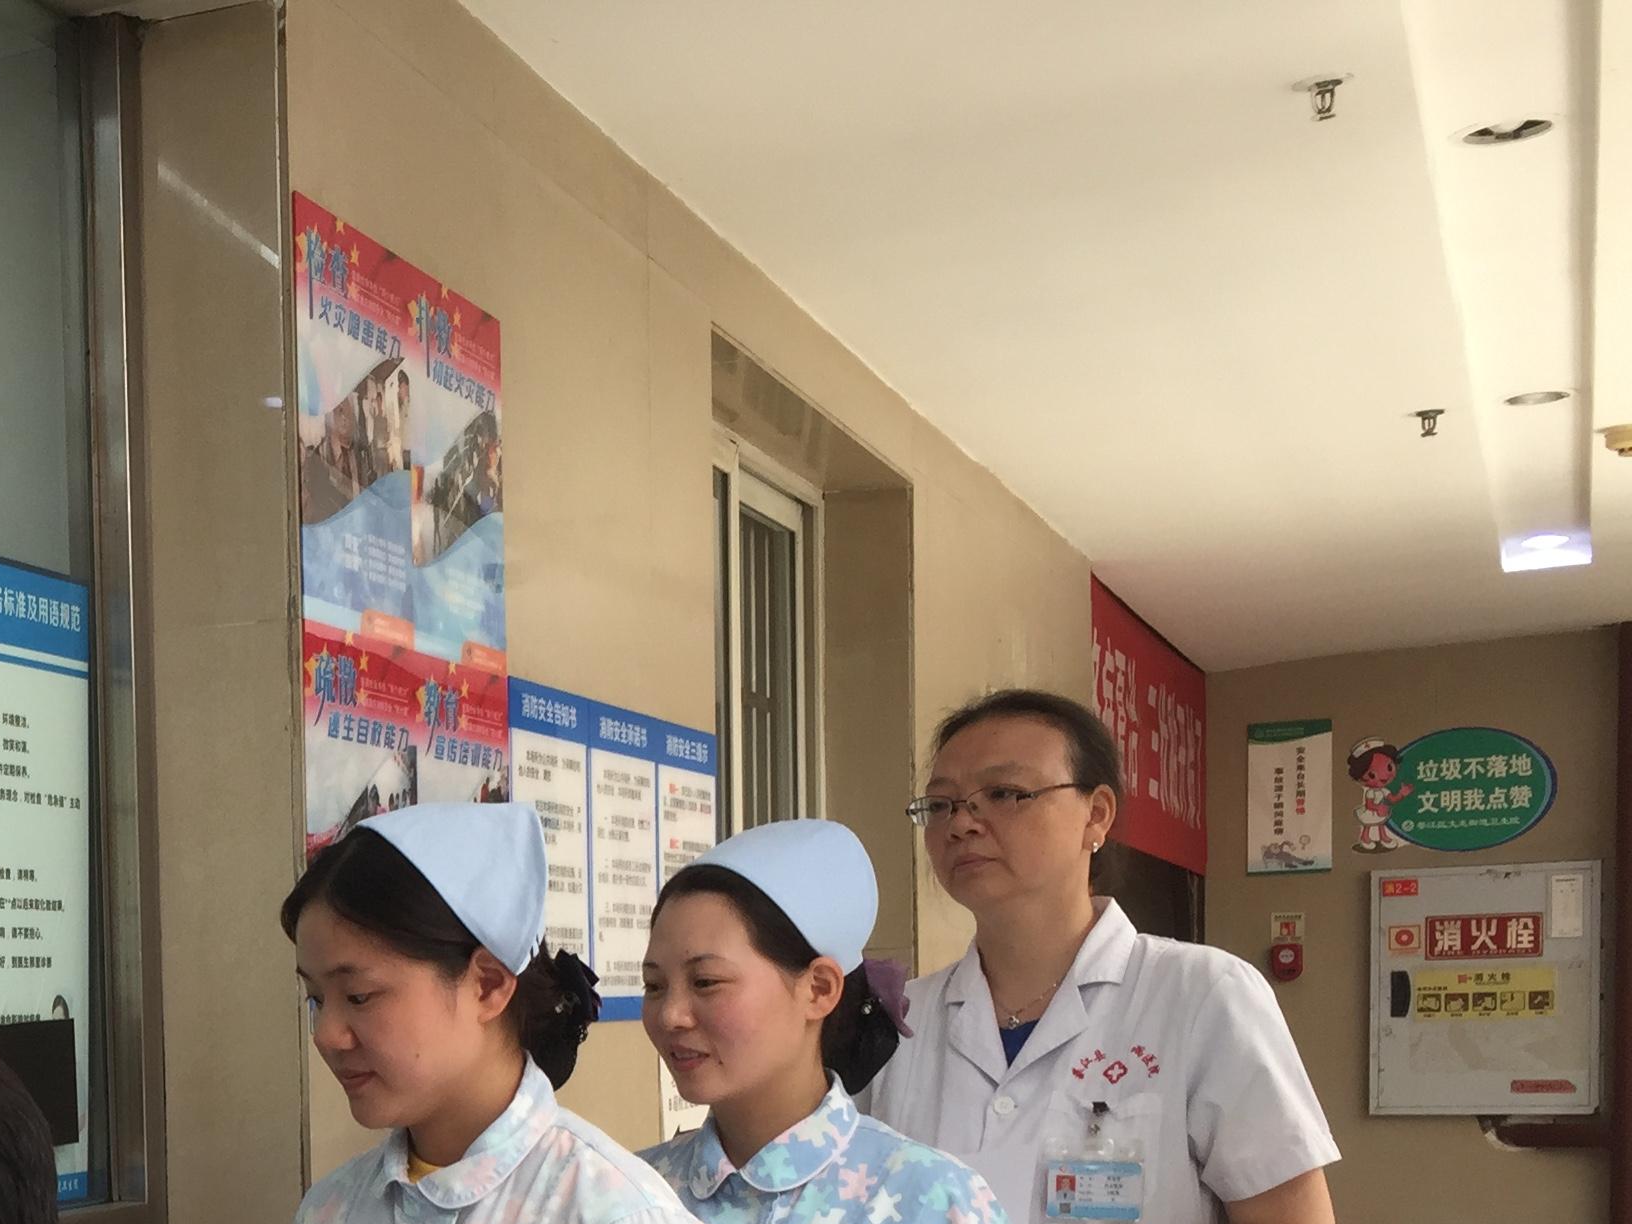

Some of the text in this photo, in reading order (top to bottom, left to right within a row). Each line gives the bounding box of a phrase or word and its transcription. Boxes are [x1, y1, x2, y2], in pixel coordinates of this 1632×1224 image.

[520, 692, 577, 729] 消防安全告知书
[1417, 754, 1533, 782] 垃圾不落地
[1418, 785, 1533, 813] 文明我点赞
[1434, 917, 1535, 951] 消火栓
